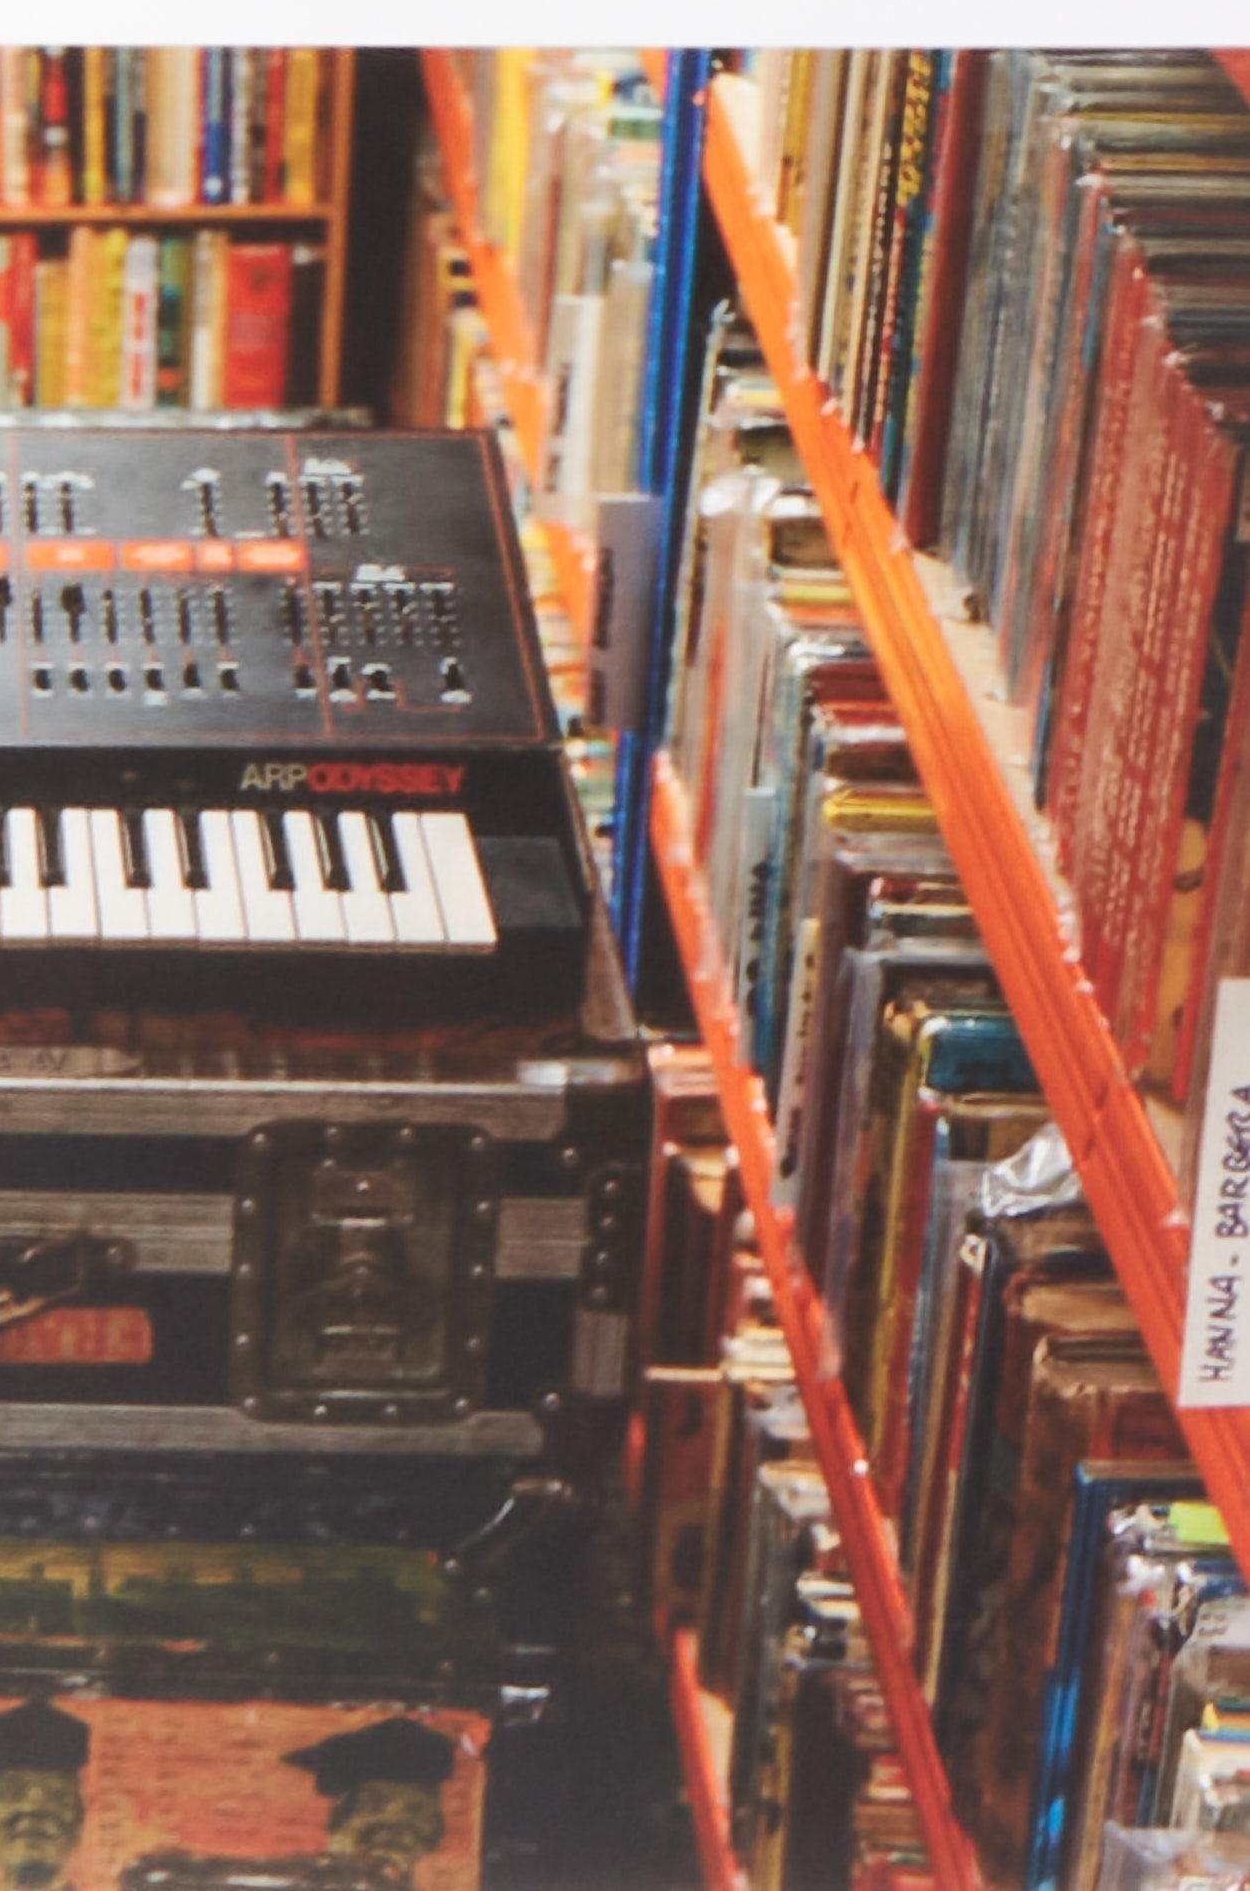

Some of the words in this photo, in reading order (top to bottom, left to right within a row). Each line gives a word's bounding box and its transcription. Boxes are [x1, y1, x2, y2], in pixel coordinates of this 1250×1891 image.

[239, 762, 307, 791] ARP
[307, 761, 467, 794] ODYSSEY
[1197, 1274, 1243, 1382] HANNA
